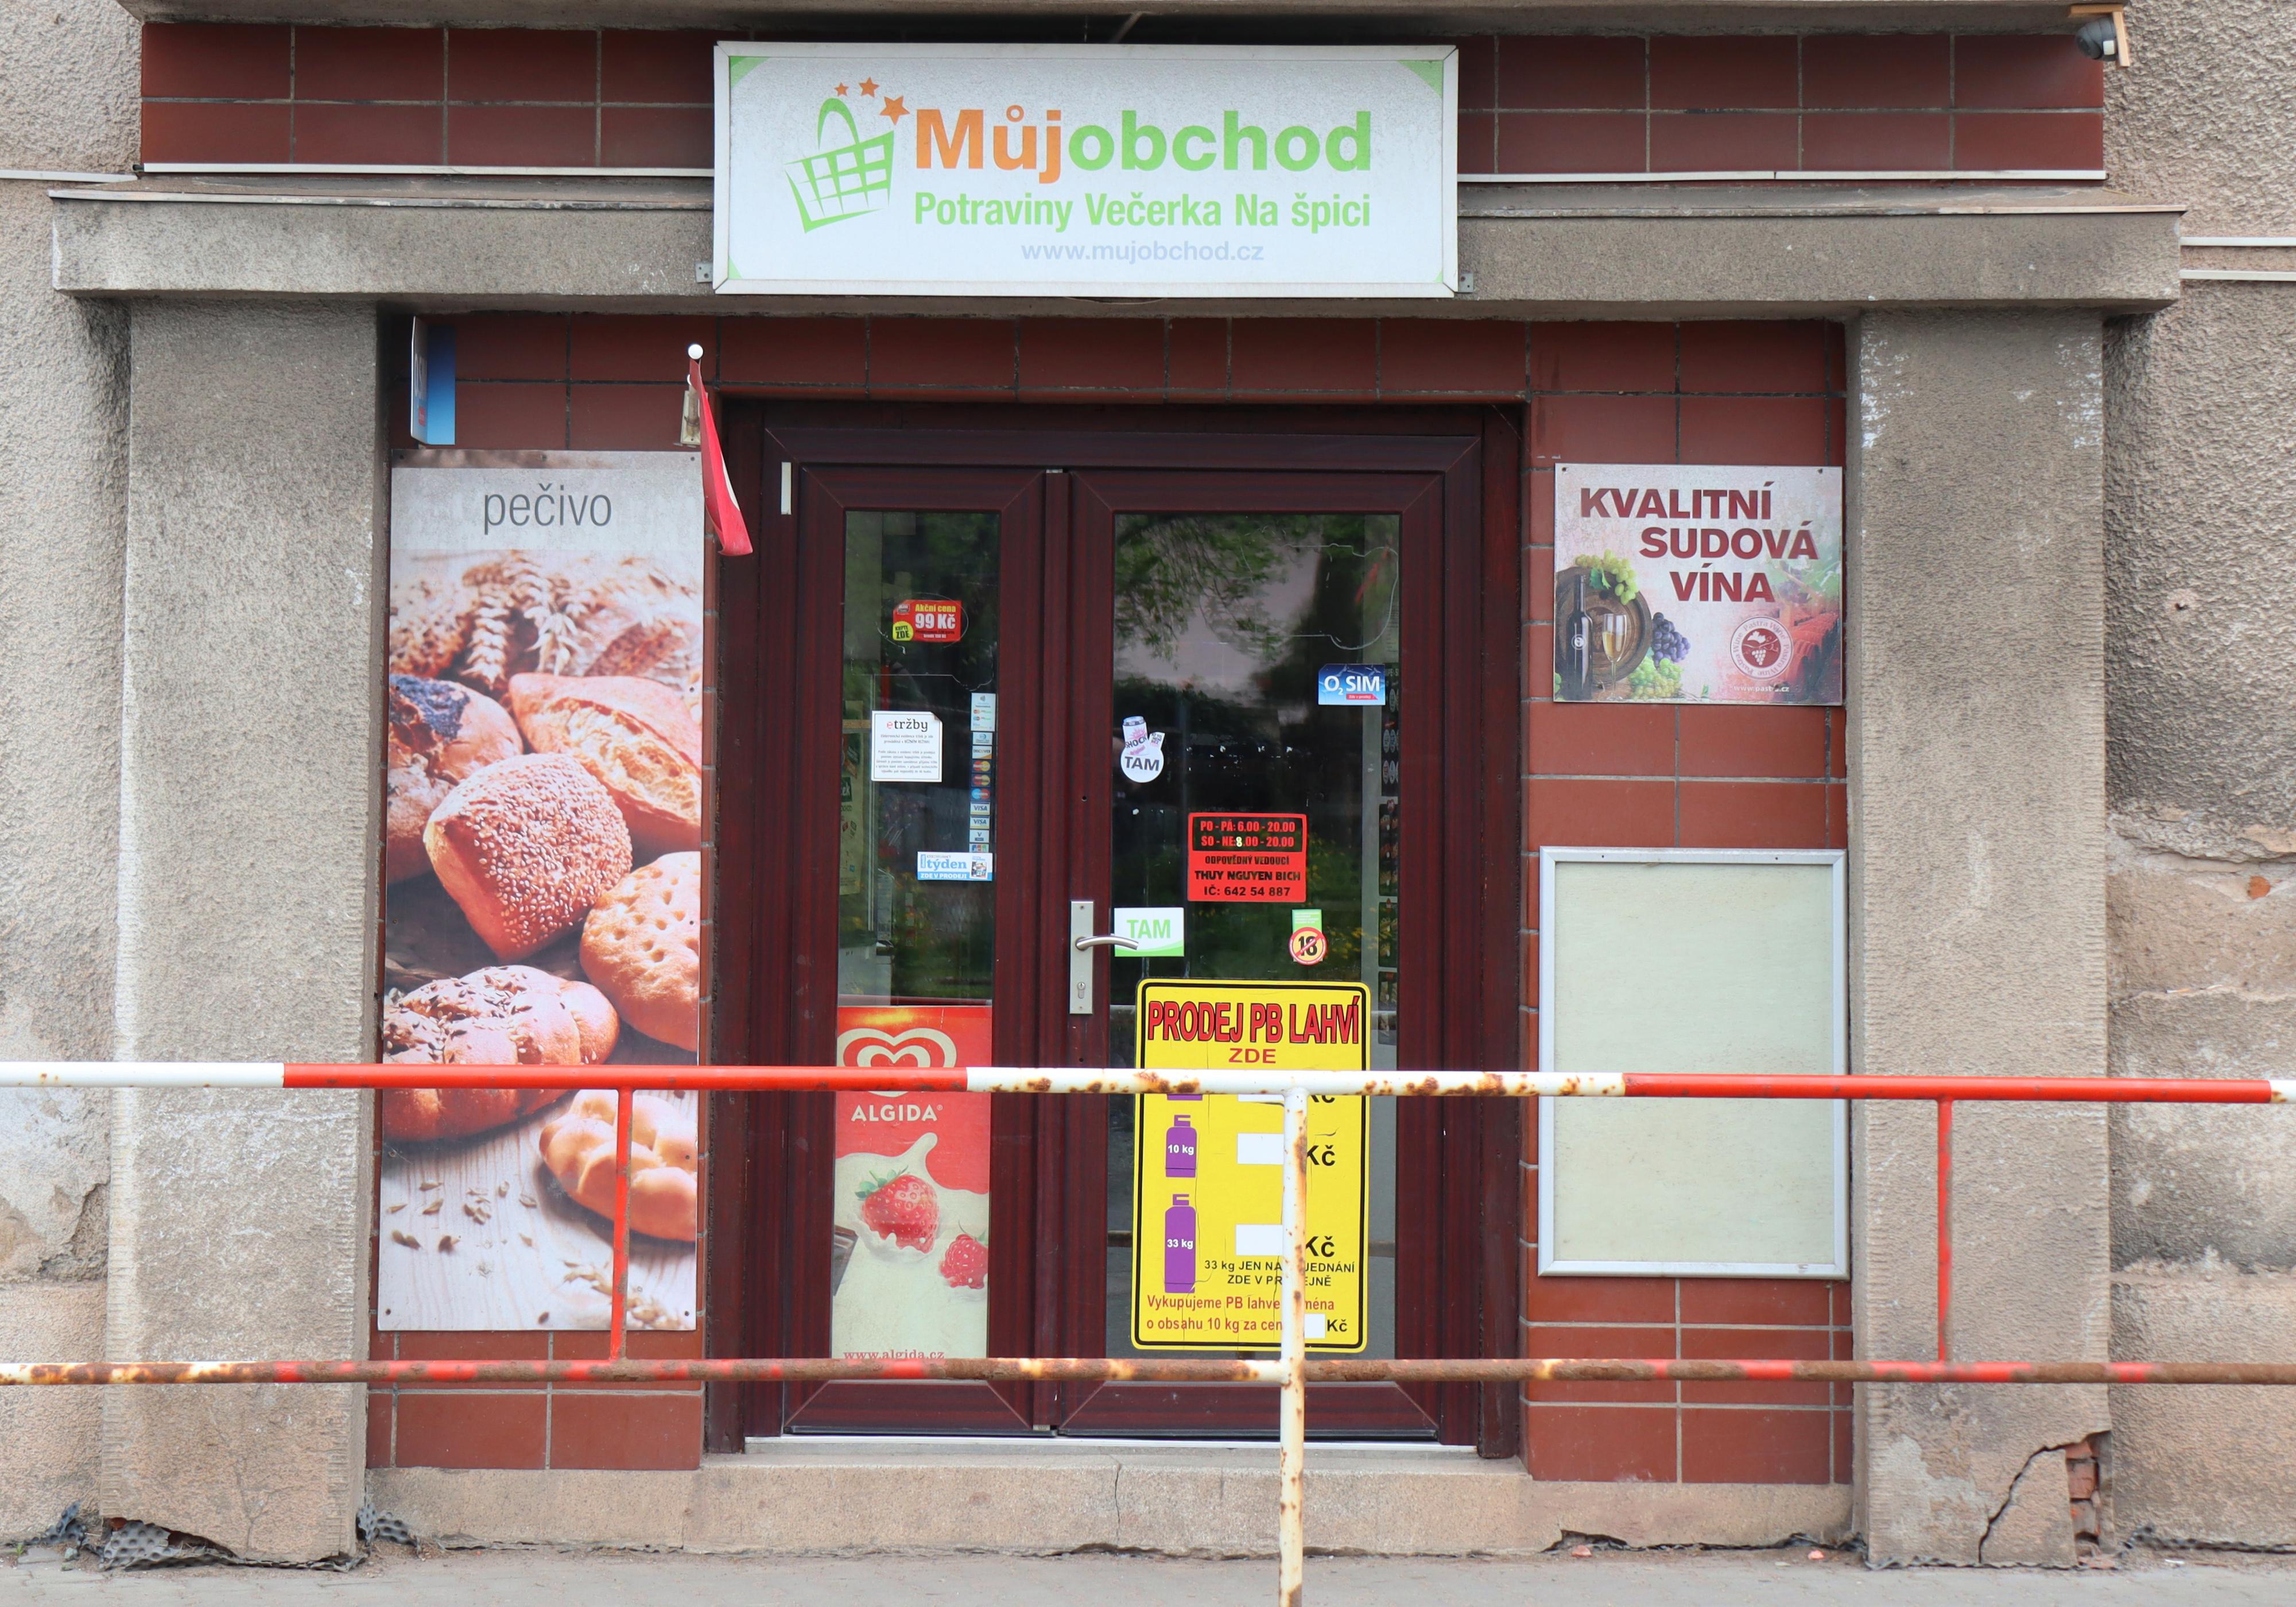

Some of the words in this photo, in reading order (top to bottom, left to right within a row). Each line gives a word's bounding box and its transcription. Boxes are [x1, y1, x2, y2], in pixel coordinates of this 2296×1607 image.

[915, 192, 1073, 233] Potraviny
[1085, 192, 1221, 226] Večerka
[1236, 193, 1278, 226] Na
[1292, 192, 1370, 233] špici
[1021, 240, 1265, 264] www.mujobchod.cz
[1580, 481, 1774, 520] KVALITNÍ
[484, 483, 612, 535] pečivo
[1639, 521, 1818, 559] SUDOVÁ
[1669, 563, 1775, 602] VÍNA
[915, 604, 936, 612] Akční
[915, 613, 934, 629] 99
[937, 614, 956, 629] Kč
[896, 630, 910, 639] ZDE
[1345, 676, 1380, 692] SIM
[887, 718, 928, 732] etržby
[1124, 756, 1159, 772] TAM
[1200, 820, 1213, 831] PO
[1221, 819, 1236, 831] PÁ:
[1238, 821, 1259, 832] 6.00
[1267, 822, 1296, 832] 20.00
[1201, 836, 1214, 846] SO
[1266, 837, 1295, 847] 20.00
[927, 859, 967, 871] týden
[1205, 854, 1253, 865] ODPOVĚDNÝ
[1255, 855, 1289, 865] VEDOUCÍ
[1194, 870, 1224, 880] THUY
[1227, 871, 1273, 881] NGUYEN
[1275, 872, 1301, 881] BICH
[1204, 884, 1220, 896] IČ:
[1224, 886, 1246, 896] 642
[1250, 887, 1265, 896] 54
[1269, 887, 1290, 896] 887
[1126, 919, 1171, 939] TAM
[1298, 936, 1318, 957] 18
[1148, 1001, 1244, 1042] PRODEJ
[1250, 1003, 1283, 1043] PB
[1289, 996, 1360, 1044] LAHVÍ
[1228, 1048, 1277, 1064] ZDE
[851, 1104, 938, 1122] ALGIDA
[1168, 1145, 1180, 1153] 10
[1182, 1144, 1194, 1156] kg
[1167, 1239, 1179, 1248] 33
[1181, 1238, 1194, 1249] kg
[1204, 1260, 1217, 1269] 33
[1221, 1261, 1235, 1272] kg
[1239, 1261, 1261, 1271] JEN
[1265, 1262, 1283, 1271] NA
[1227, 1275, 1251, 1284] ZDE
[1255, 1276, 1263, 1284] V
[1147, 1295, 1222, 1311] Vykupujeme
[1226, 1296, 1243, 1309] PB
[1248, 1297, 1281, 1310] lahve
[1147, 1319, 1154, 1329] o
[1158, 1317, 1203, 1330] obsahu
[1208, 1318, 1220, 1330] 10
[1225, 1318, 1239, 1334] kg
[1243, 1321, 1257, 1330] za
[1327, 1319, 1348, 1332] Kč
[844, 1349, 945, 1359] www.algida.cz
